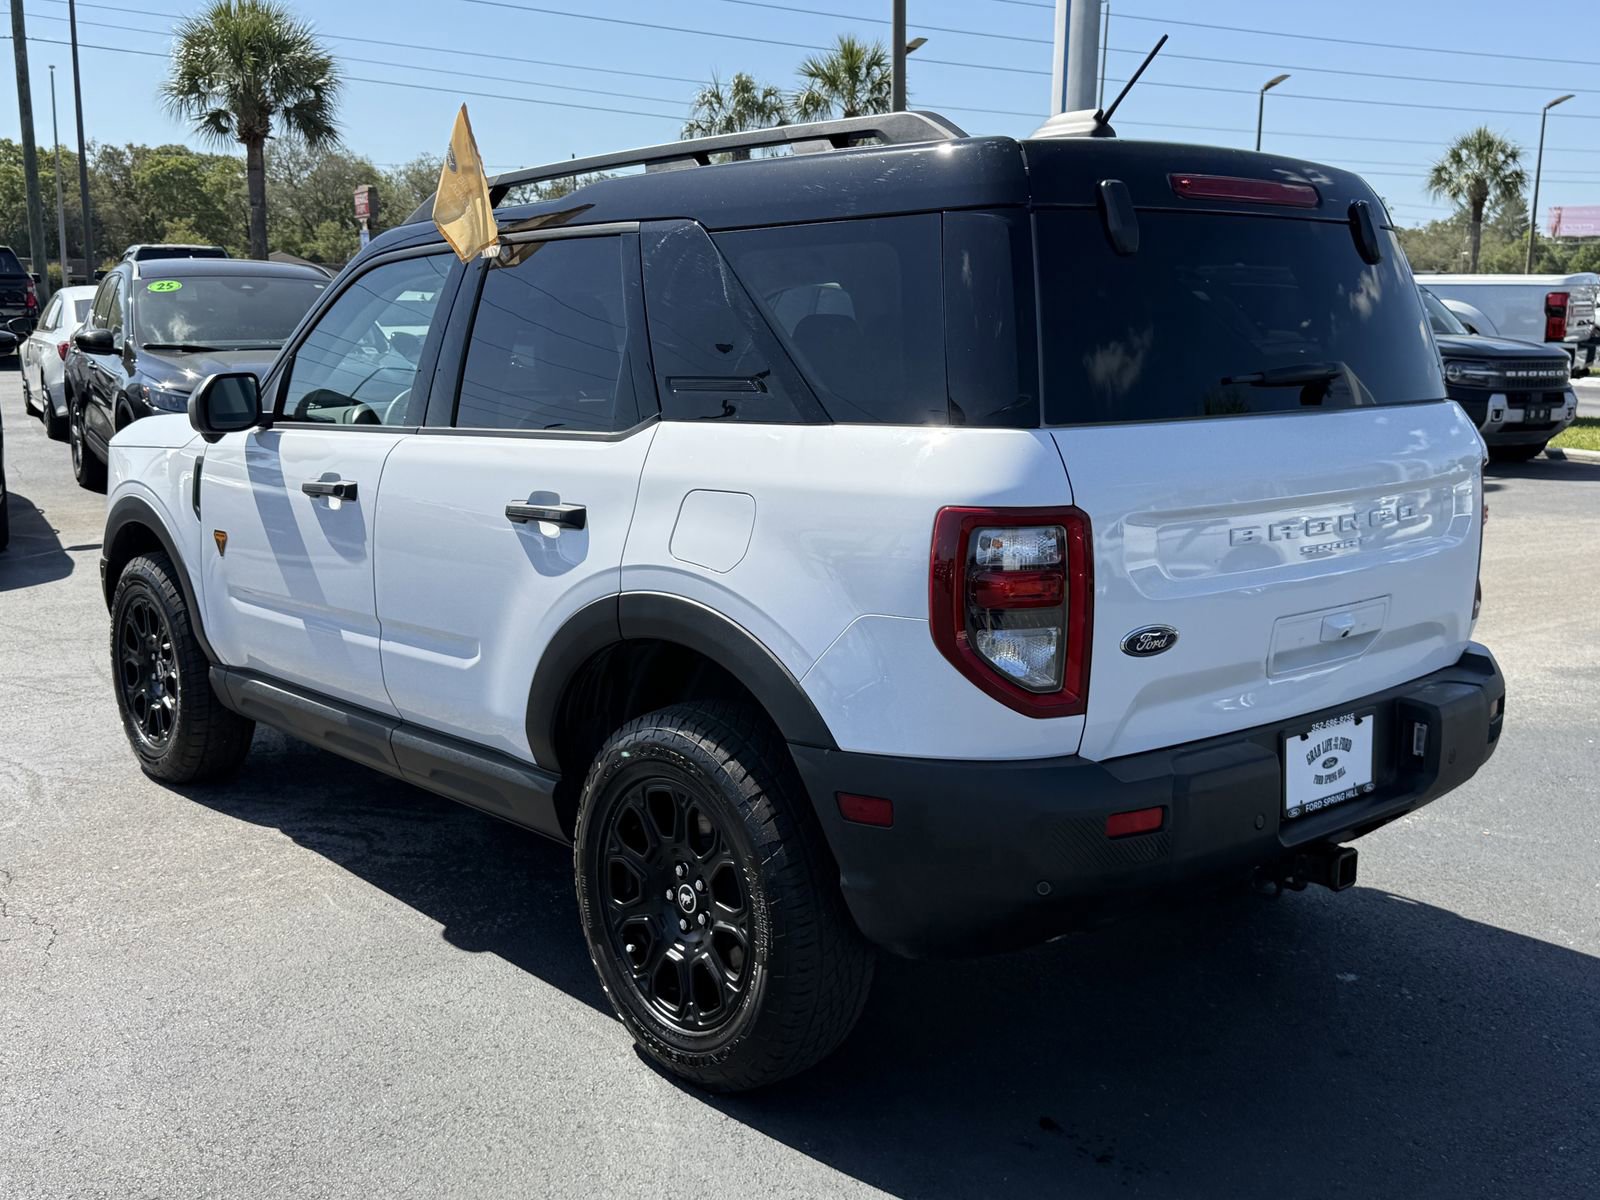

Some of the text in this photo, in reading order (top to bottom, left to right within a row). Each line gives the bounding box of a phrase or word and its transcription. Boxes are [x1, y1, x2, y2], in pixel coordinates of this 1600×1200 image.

[156, 282, 174, 290] 25
[1230, 502, 1420, 547] BRONCO
[1136, 632, 1168, 651] Ford
[1306, 743, 1322, 766] GRAB
[1322, 737, 1333, 754] LIFE
[1305, 786, 1359, 813] FORD SPRING HILL
